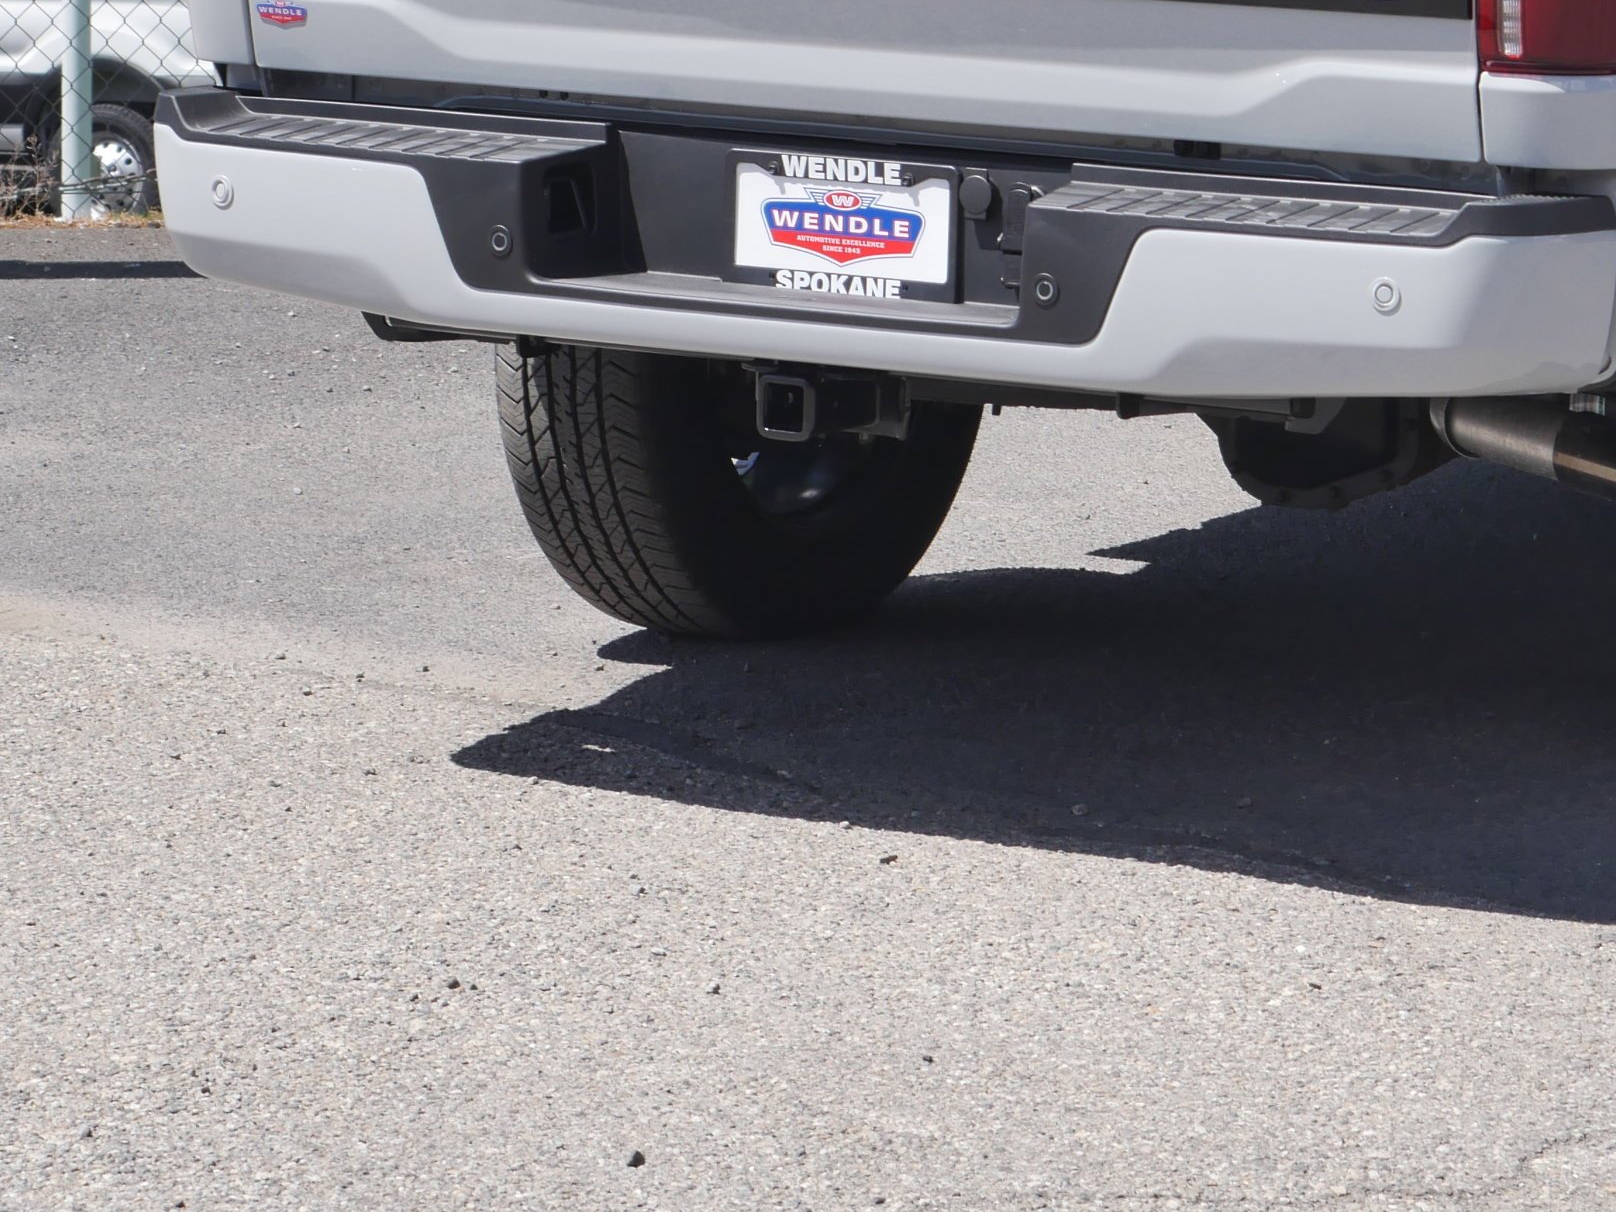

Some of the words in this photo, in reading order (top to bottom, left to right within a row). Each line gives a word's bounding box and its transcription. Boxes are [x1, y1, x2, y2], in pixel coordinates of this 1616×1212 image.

[259, 6, 302, 16] WENDLE
[781, 154, 901, 186] WENDLE
[772, 209, 910, 238] WENDLE
[797, 234, 840, 245] AUTOMOTIVE
[842, 238, 885, 249] EXCELLENCE
[822, 245, 843, 253] SINCE
[775, 269, 901, 300] SPOKANE
